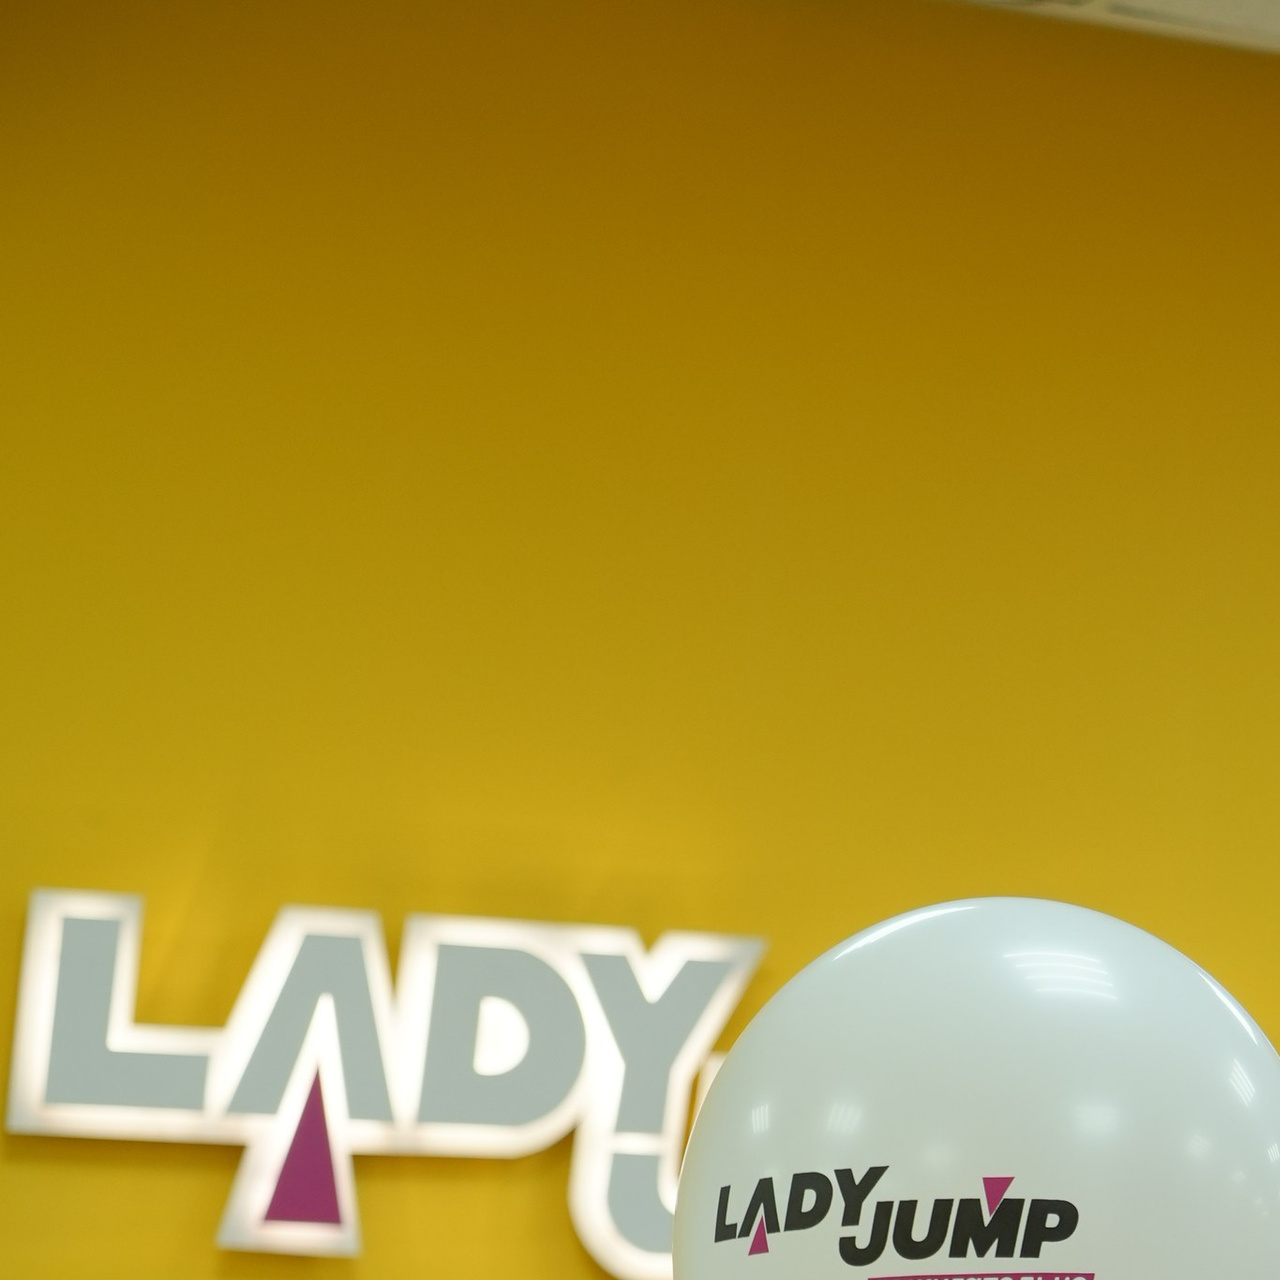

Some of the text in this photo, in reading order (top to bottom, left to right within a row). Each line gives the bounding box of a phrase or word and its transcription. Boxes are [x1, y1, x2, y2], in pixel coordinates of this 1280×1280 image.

[40, 912, 742, 1226] LADY
[714, 1165, 890, 1256] LADY
[838, 1177, 1080, 1267] JUMP
